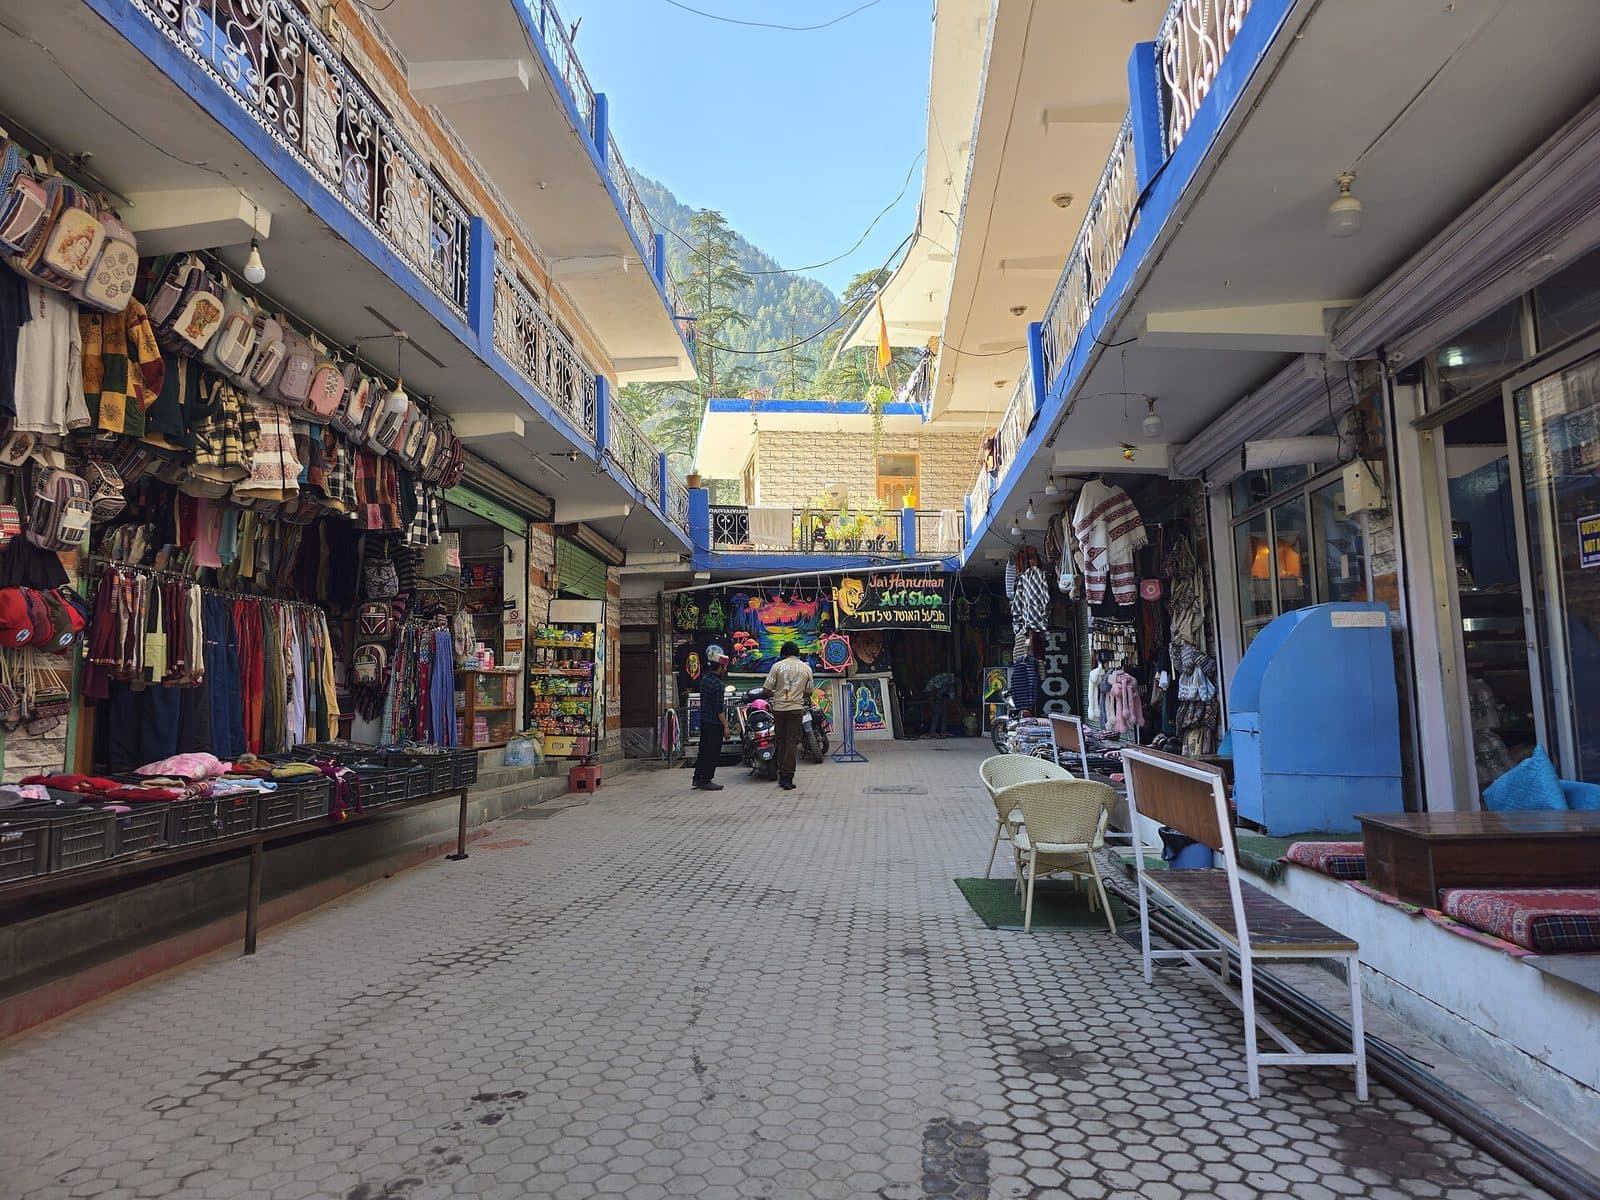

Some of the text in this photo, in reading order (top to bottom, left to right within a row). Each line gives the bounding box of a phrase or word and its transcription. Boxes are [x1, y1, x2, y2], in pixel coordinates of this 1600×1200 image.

[869, 573, 945, 590] Jai Hanuman
[878, 589, 943, 610] Art Shop
[877, 610, 893, 623] של
